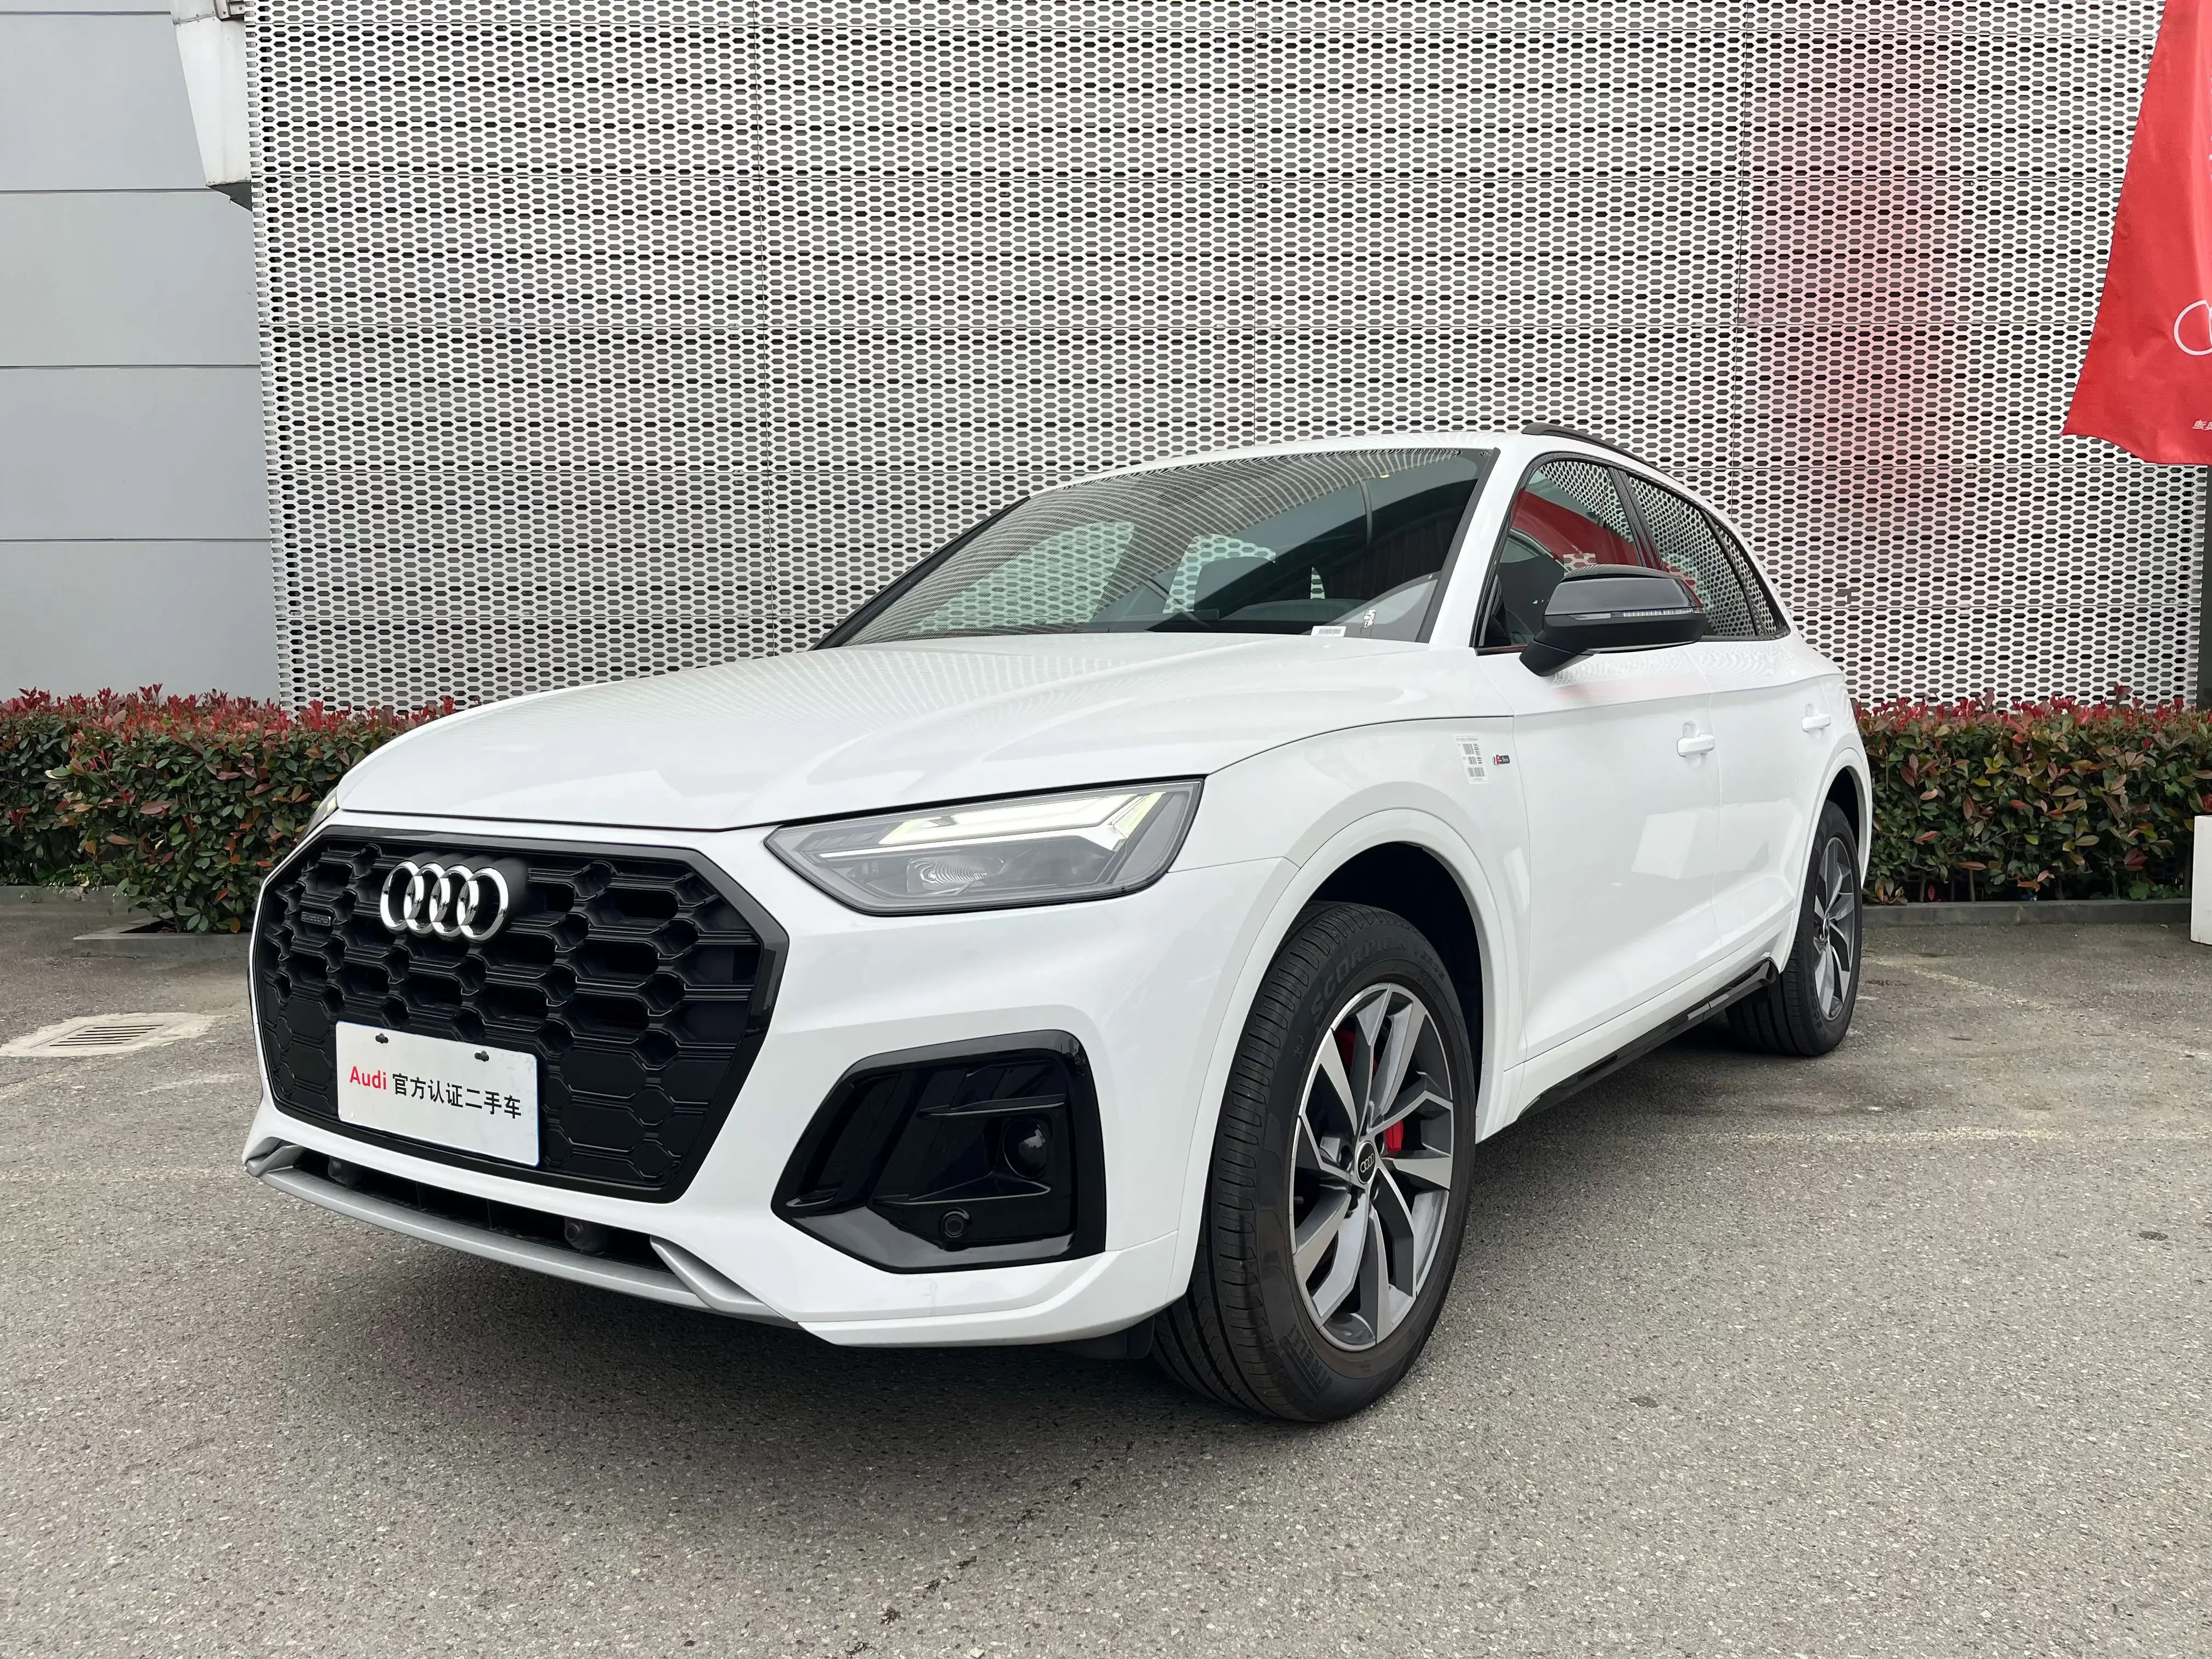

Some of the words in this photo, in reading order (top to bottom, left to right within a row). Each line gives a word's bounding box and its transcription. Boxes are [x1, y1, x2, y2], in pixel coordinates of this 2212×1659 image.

[1310, 935, 1408, 1025] SCORPION
[349, 1066, 387, 1090] Audi
[392, 1073, 522, 1119] 官方认证二手车
